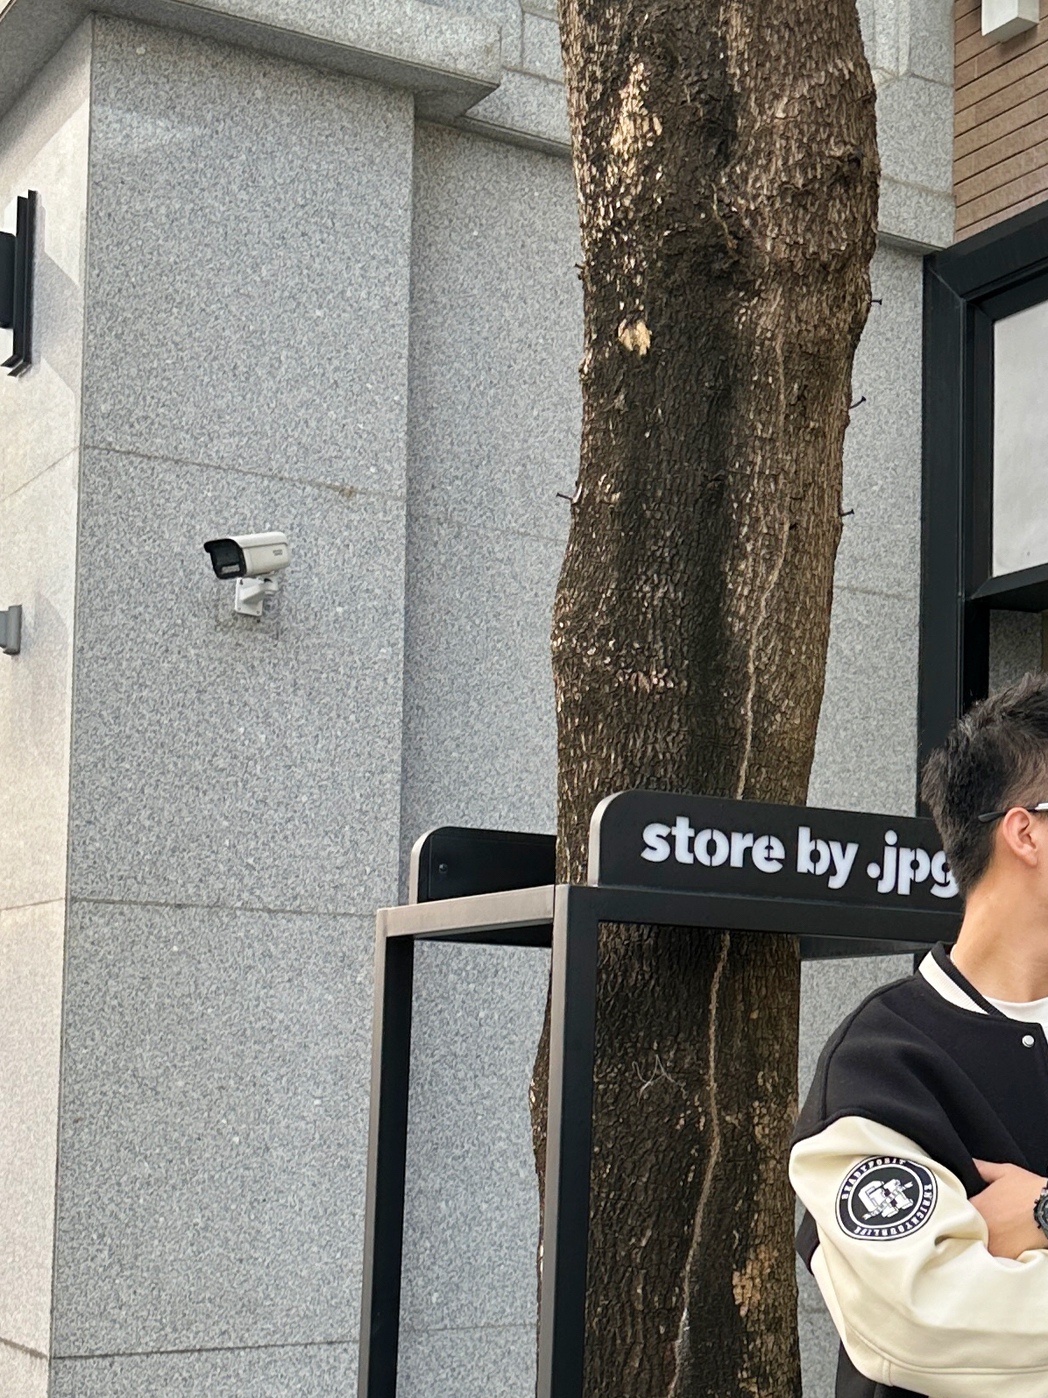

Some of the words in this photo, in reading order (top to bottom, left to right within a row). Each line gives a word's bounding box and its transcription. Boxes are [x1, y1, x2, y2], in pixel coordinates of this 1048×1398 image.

[640, 815, 786, 873] store
[797, 826, 859, 890] by
[866, 829, 960, 899] .jpg
